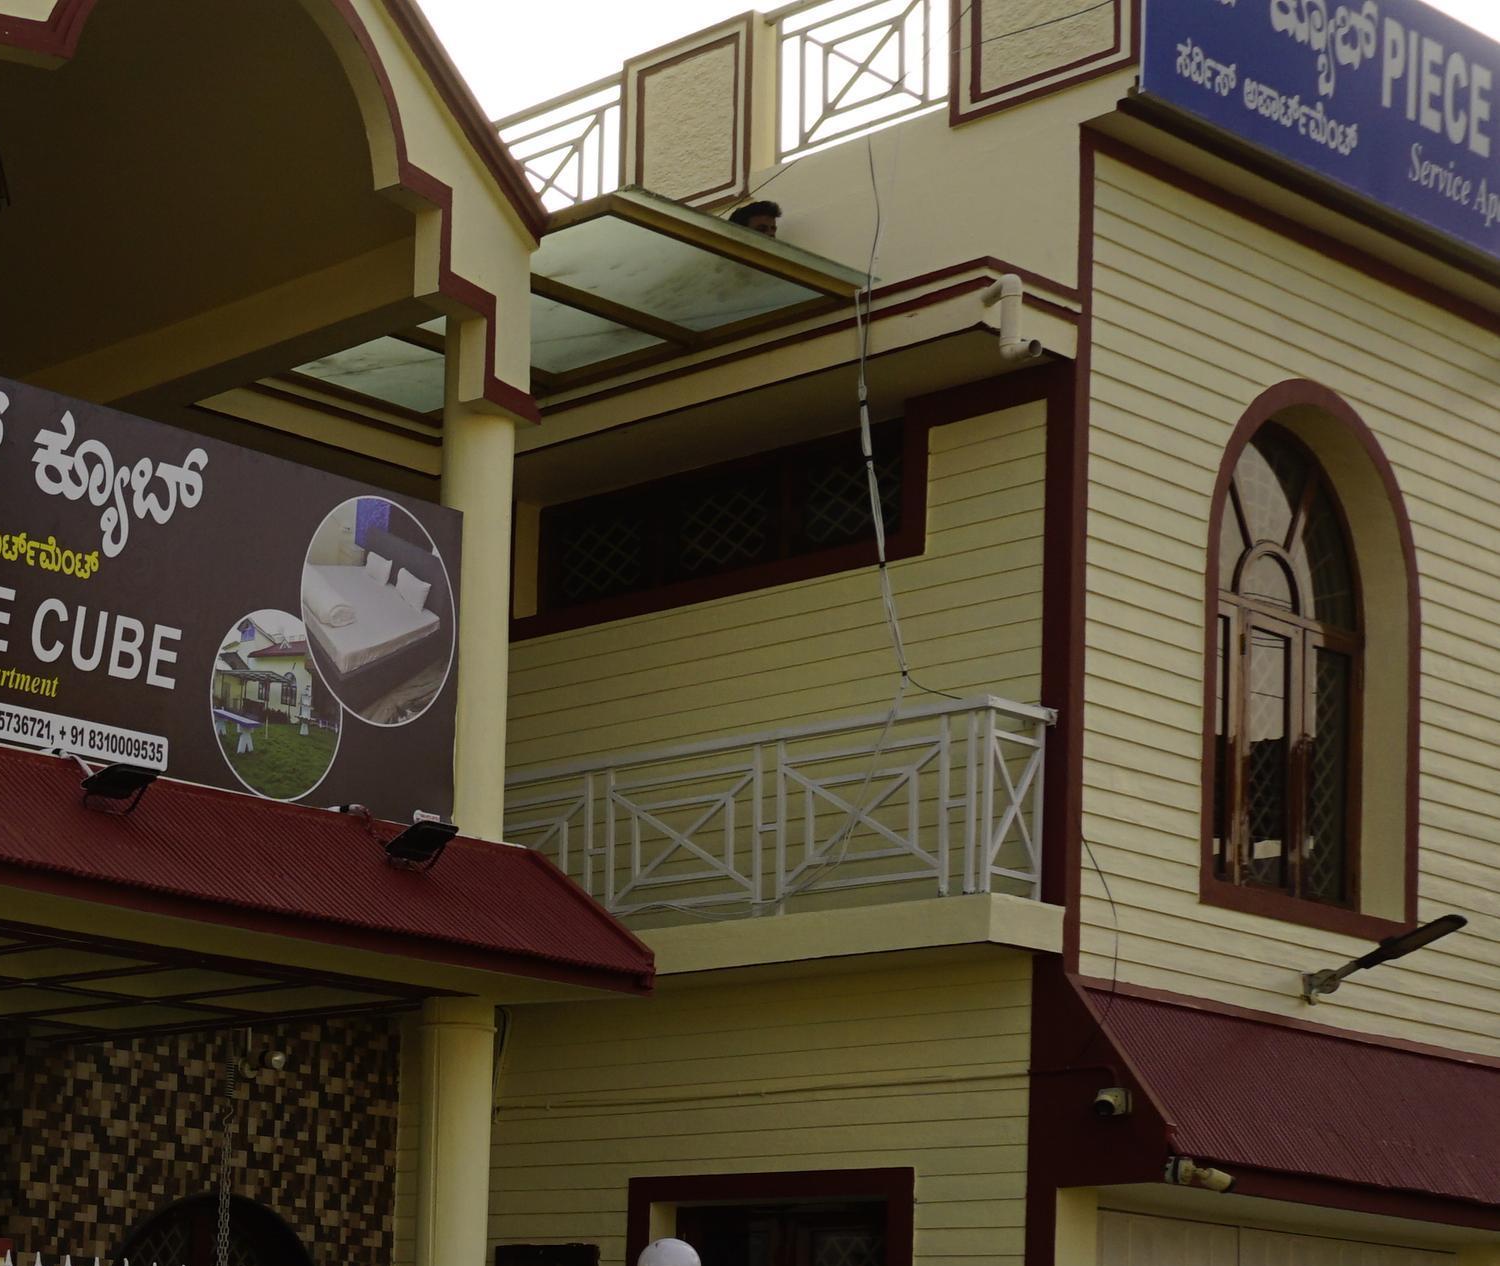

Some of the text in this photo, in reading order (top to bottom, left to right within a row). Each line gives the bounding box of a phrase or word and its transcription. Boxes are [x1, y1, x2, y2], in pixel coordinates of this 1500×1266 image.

[1381, 17, 1493, 159] PIECE
[1408, 142, 1474, 206] Service
[31, 410, 209, 558] ಕ್ಯೂಬ್
[31, 597, 184, 690] CUBE
[70, 725, 86, 747] 91
[88, 730, 165, 763] 8310009535
